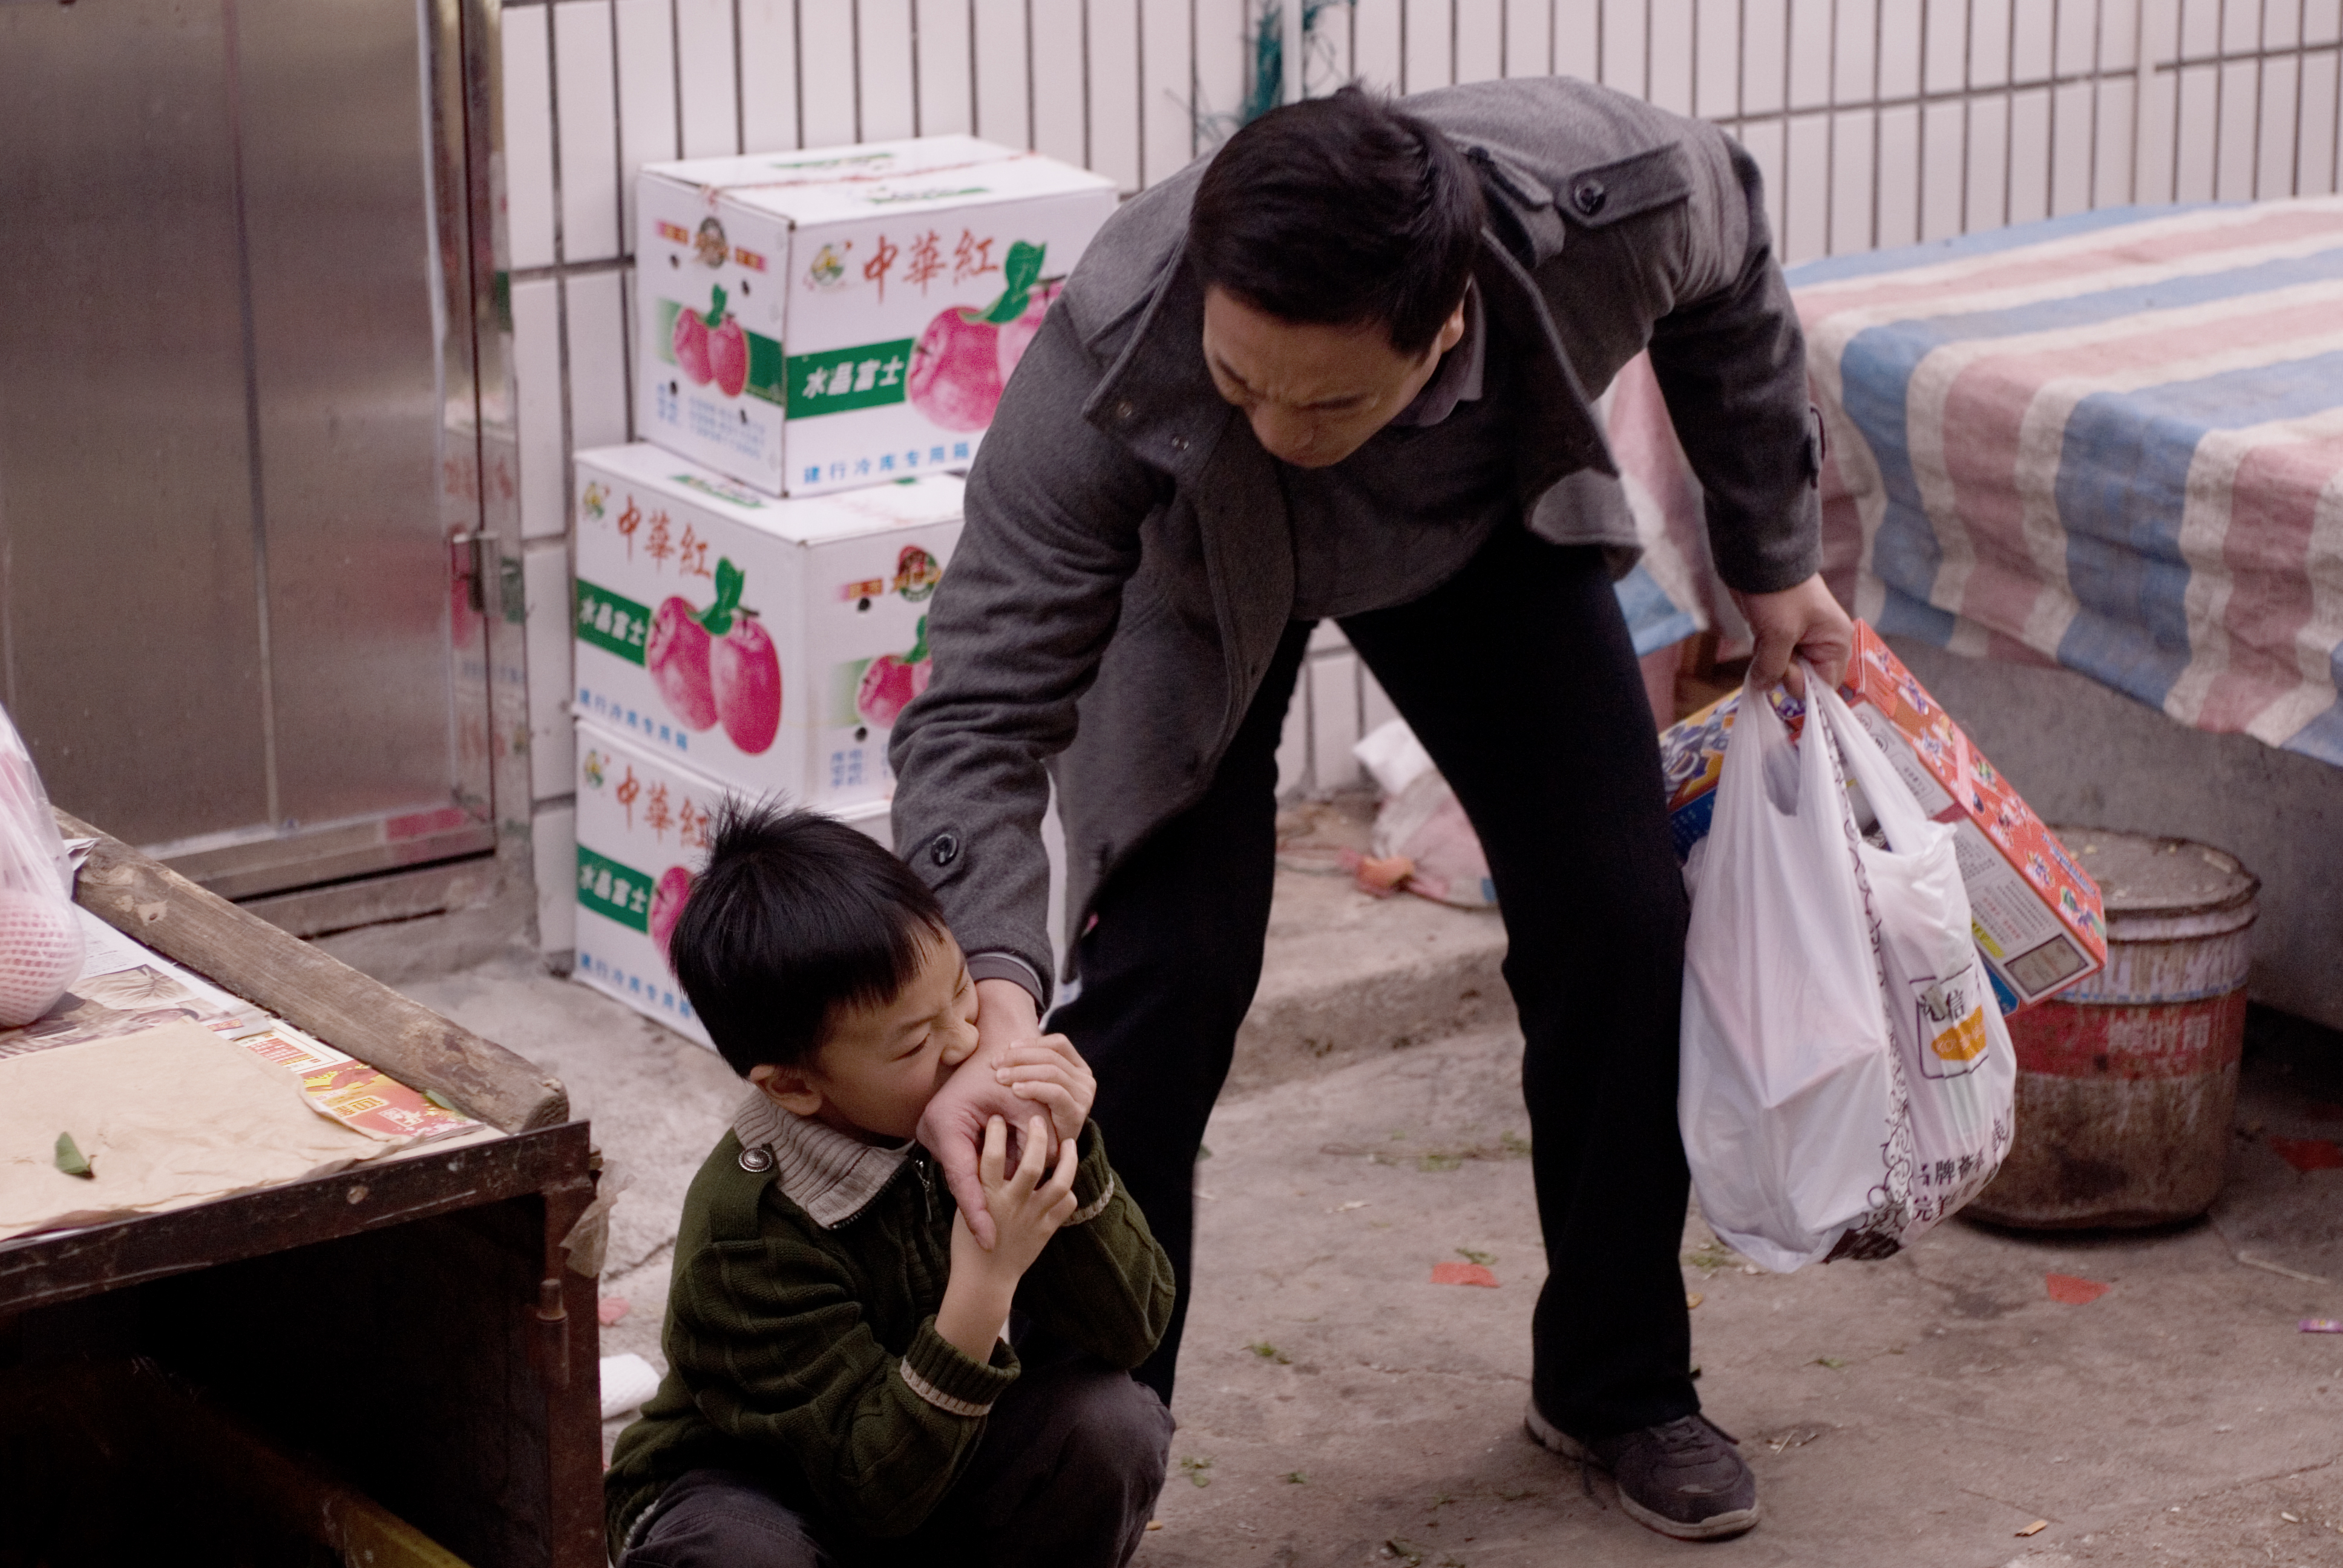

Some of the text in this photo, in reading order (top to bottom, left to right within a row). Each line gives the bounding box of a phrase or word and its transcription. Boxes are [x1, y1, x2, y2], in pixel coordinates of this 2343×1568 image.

[863, 228, 998, 304] 中華紅
[802, 355, 903, 399] 水晶富士
[617, 492, 713, 579] 中華紅
